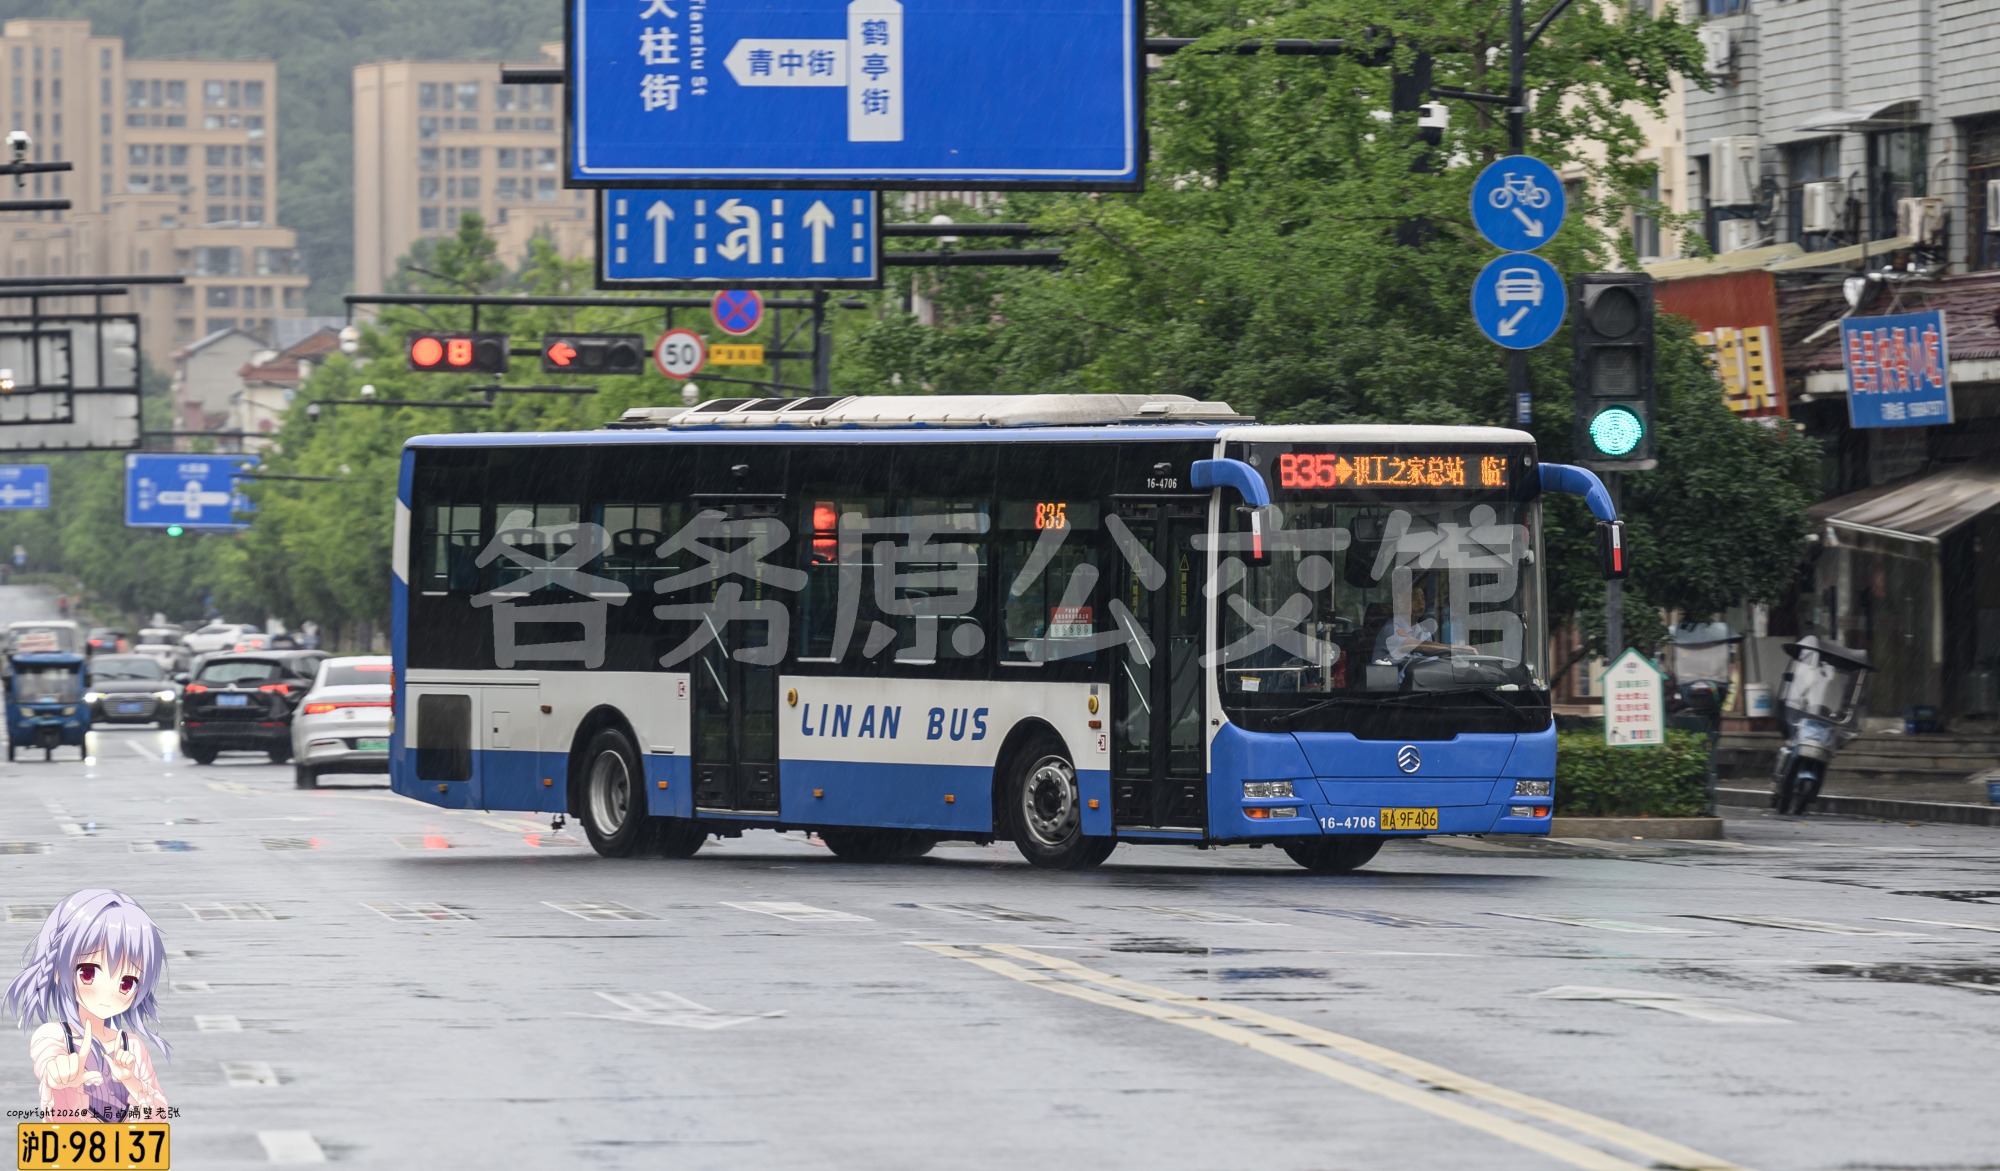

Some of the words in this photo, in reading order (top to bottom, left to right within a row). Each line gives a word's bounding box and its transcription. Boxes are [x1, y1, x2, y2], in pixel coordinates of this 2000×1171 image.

[747, 48, 836, 77] 青中街
[861, 18, 890, 116] 鹤亭街
[665, 342, 695, 367] 50
[1146, 477, 1178, 490] 16-4706
[1480, 456, 1507, 486] 临
[1035, 502, 1067, 530] 835
[926, 706, 989, 742] BUS
[1319, 815, 1377, 830] 16-4706
